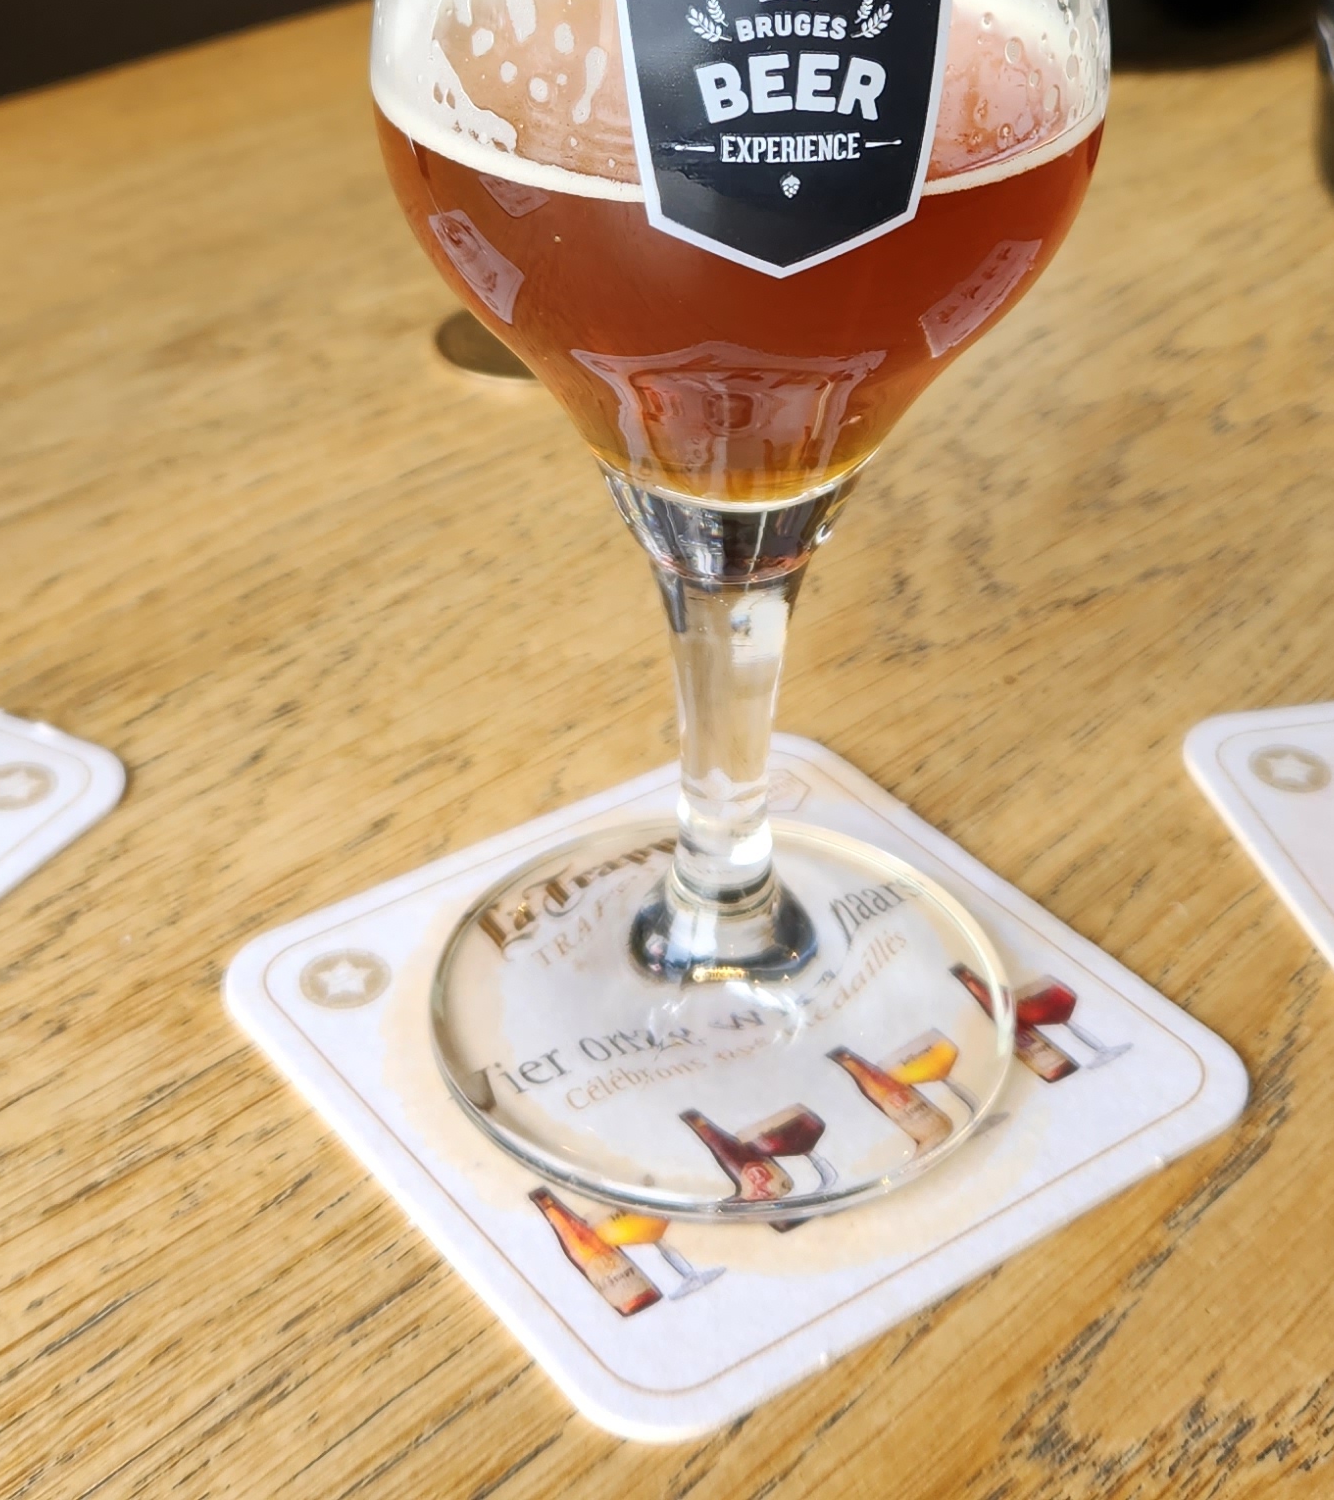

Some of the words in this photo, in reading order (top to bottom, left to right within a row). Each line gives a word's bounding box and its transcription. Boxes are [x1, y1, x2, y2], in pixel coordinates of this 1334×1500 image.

[734, 11, 848, 43] BRUGES
[693, 50, 887, 125] BEER
[721, 132, 861, 164] EXPERIENCE
[565, 1057, 709, 1112] Célébrons
